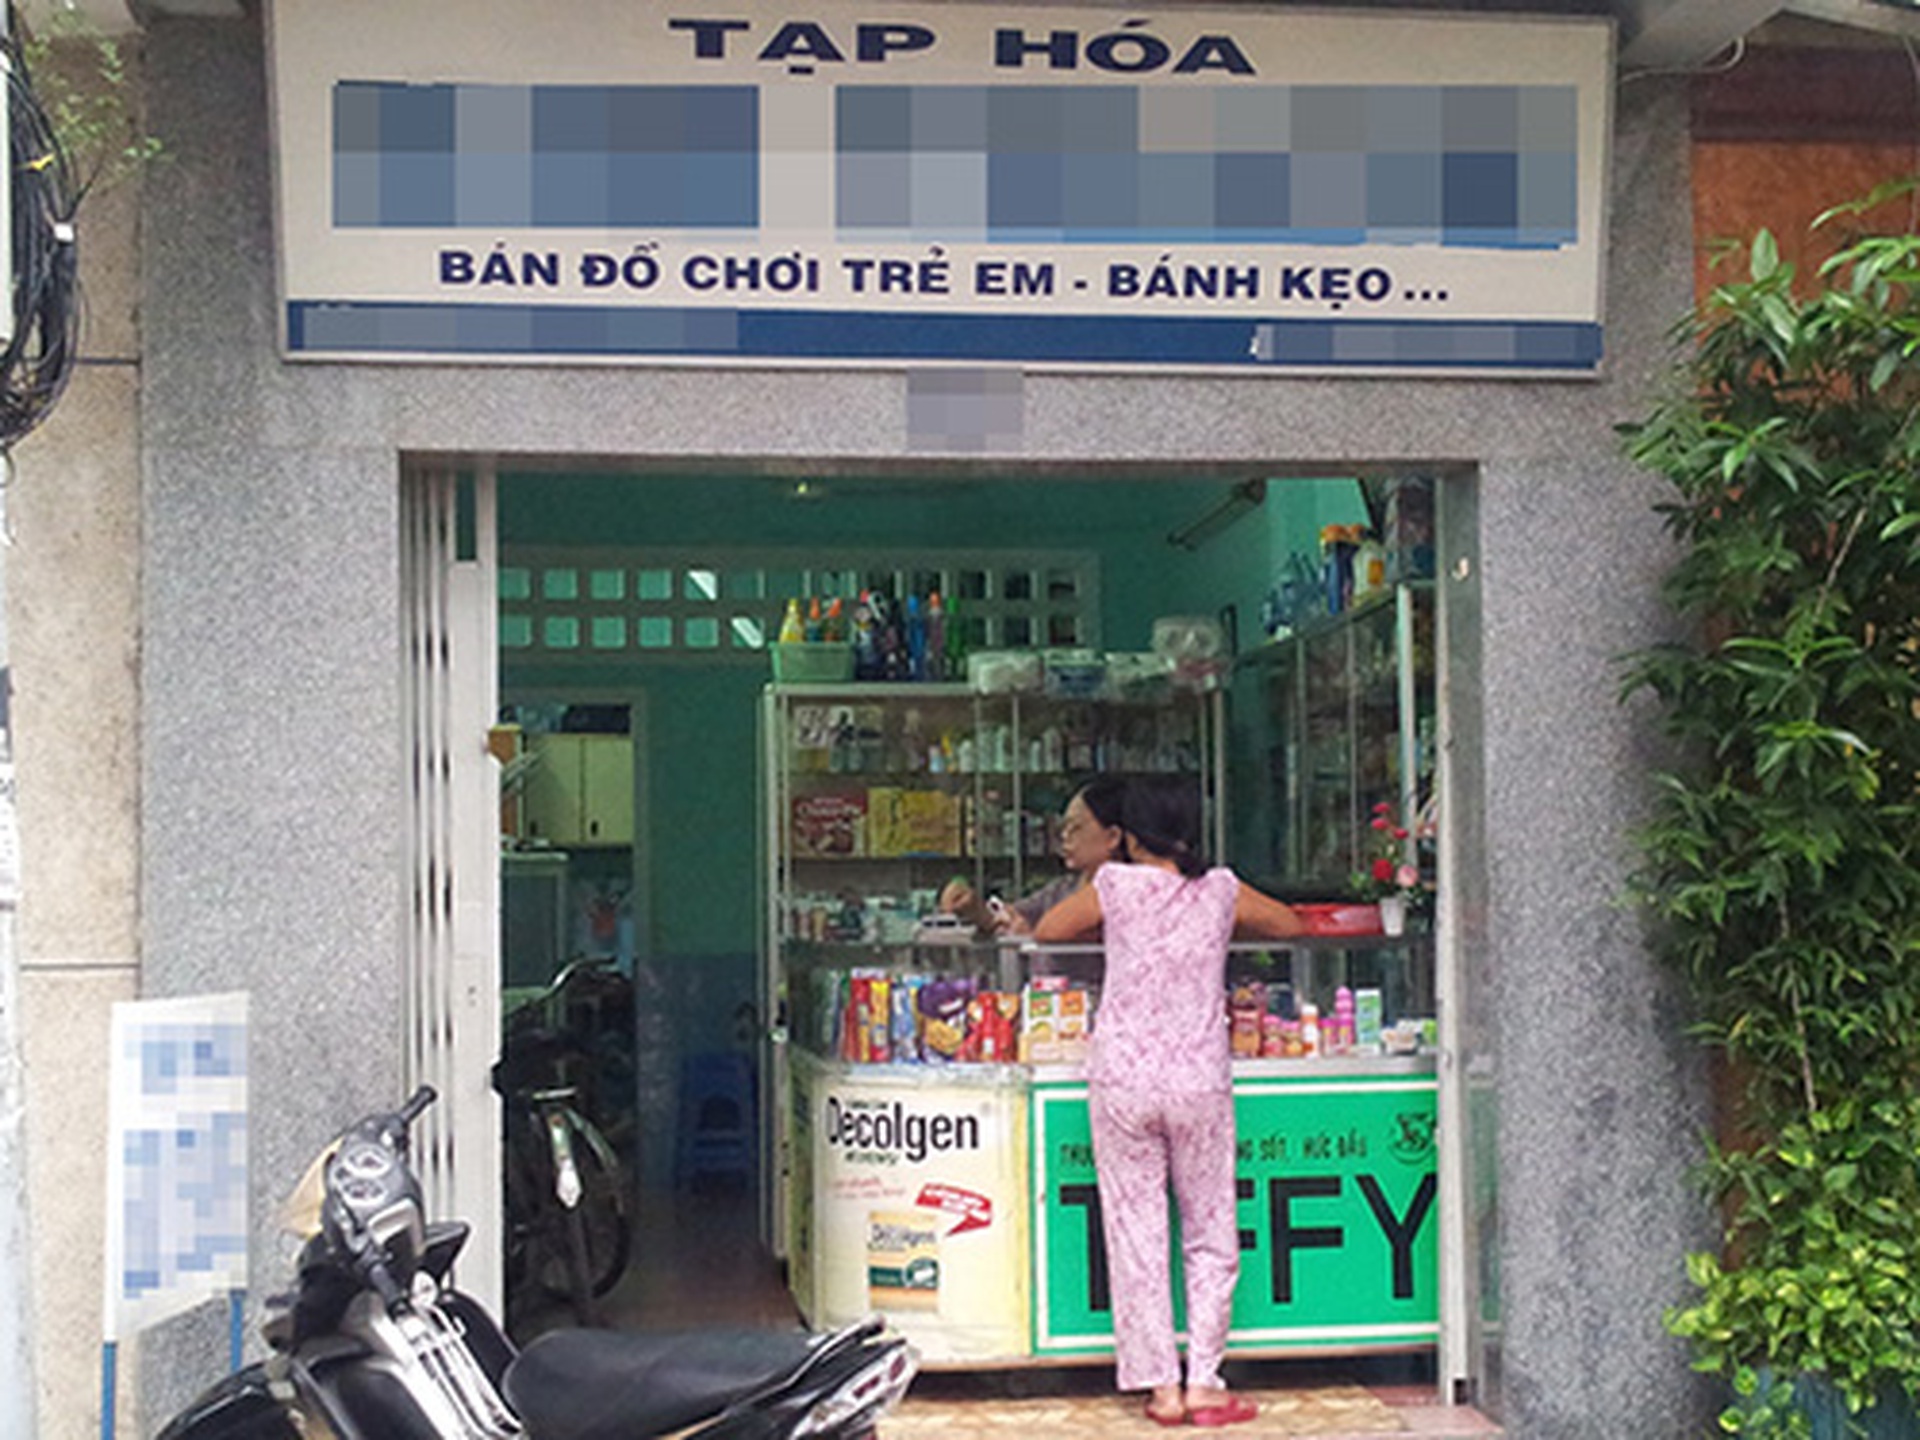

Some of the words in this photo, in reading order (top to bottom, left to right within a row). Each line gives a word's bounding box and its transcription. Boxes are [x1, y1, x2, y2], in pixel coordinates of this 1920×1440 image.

[668, 18, 936, 75] TẠP
[994, 20, 1256, 76] HÓA
[439, 241, 560, 287] BÁN
[682, 250, 820, 291] CHƠI
[842, 246, 951, 294] TRẺ
[974, 262, 1055, 296] EM
[1107, 254, 1260, 300] BÁNH
[826, 1096, 979, 1163] Decolgen
